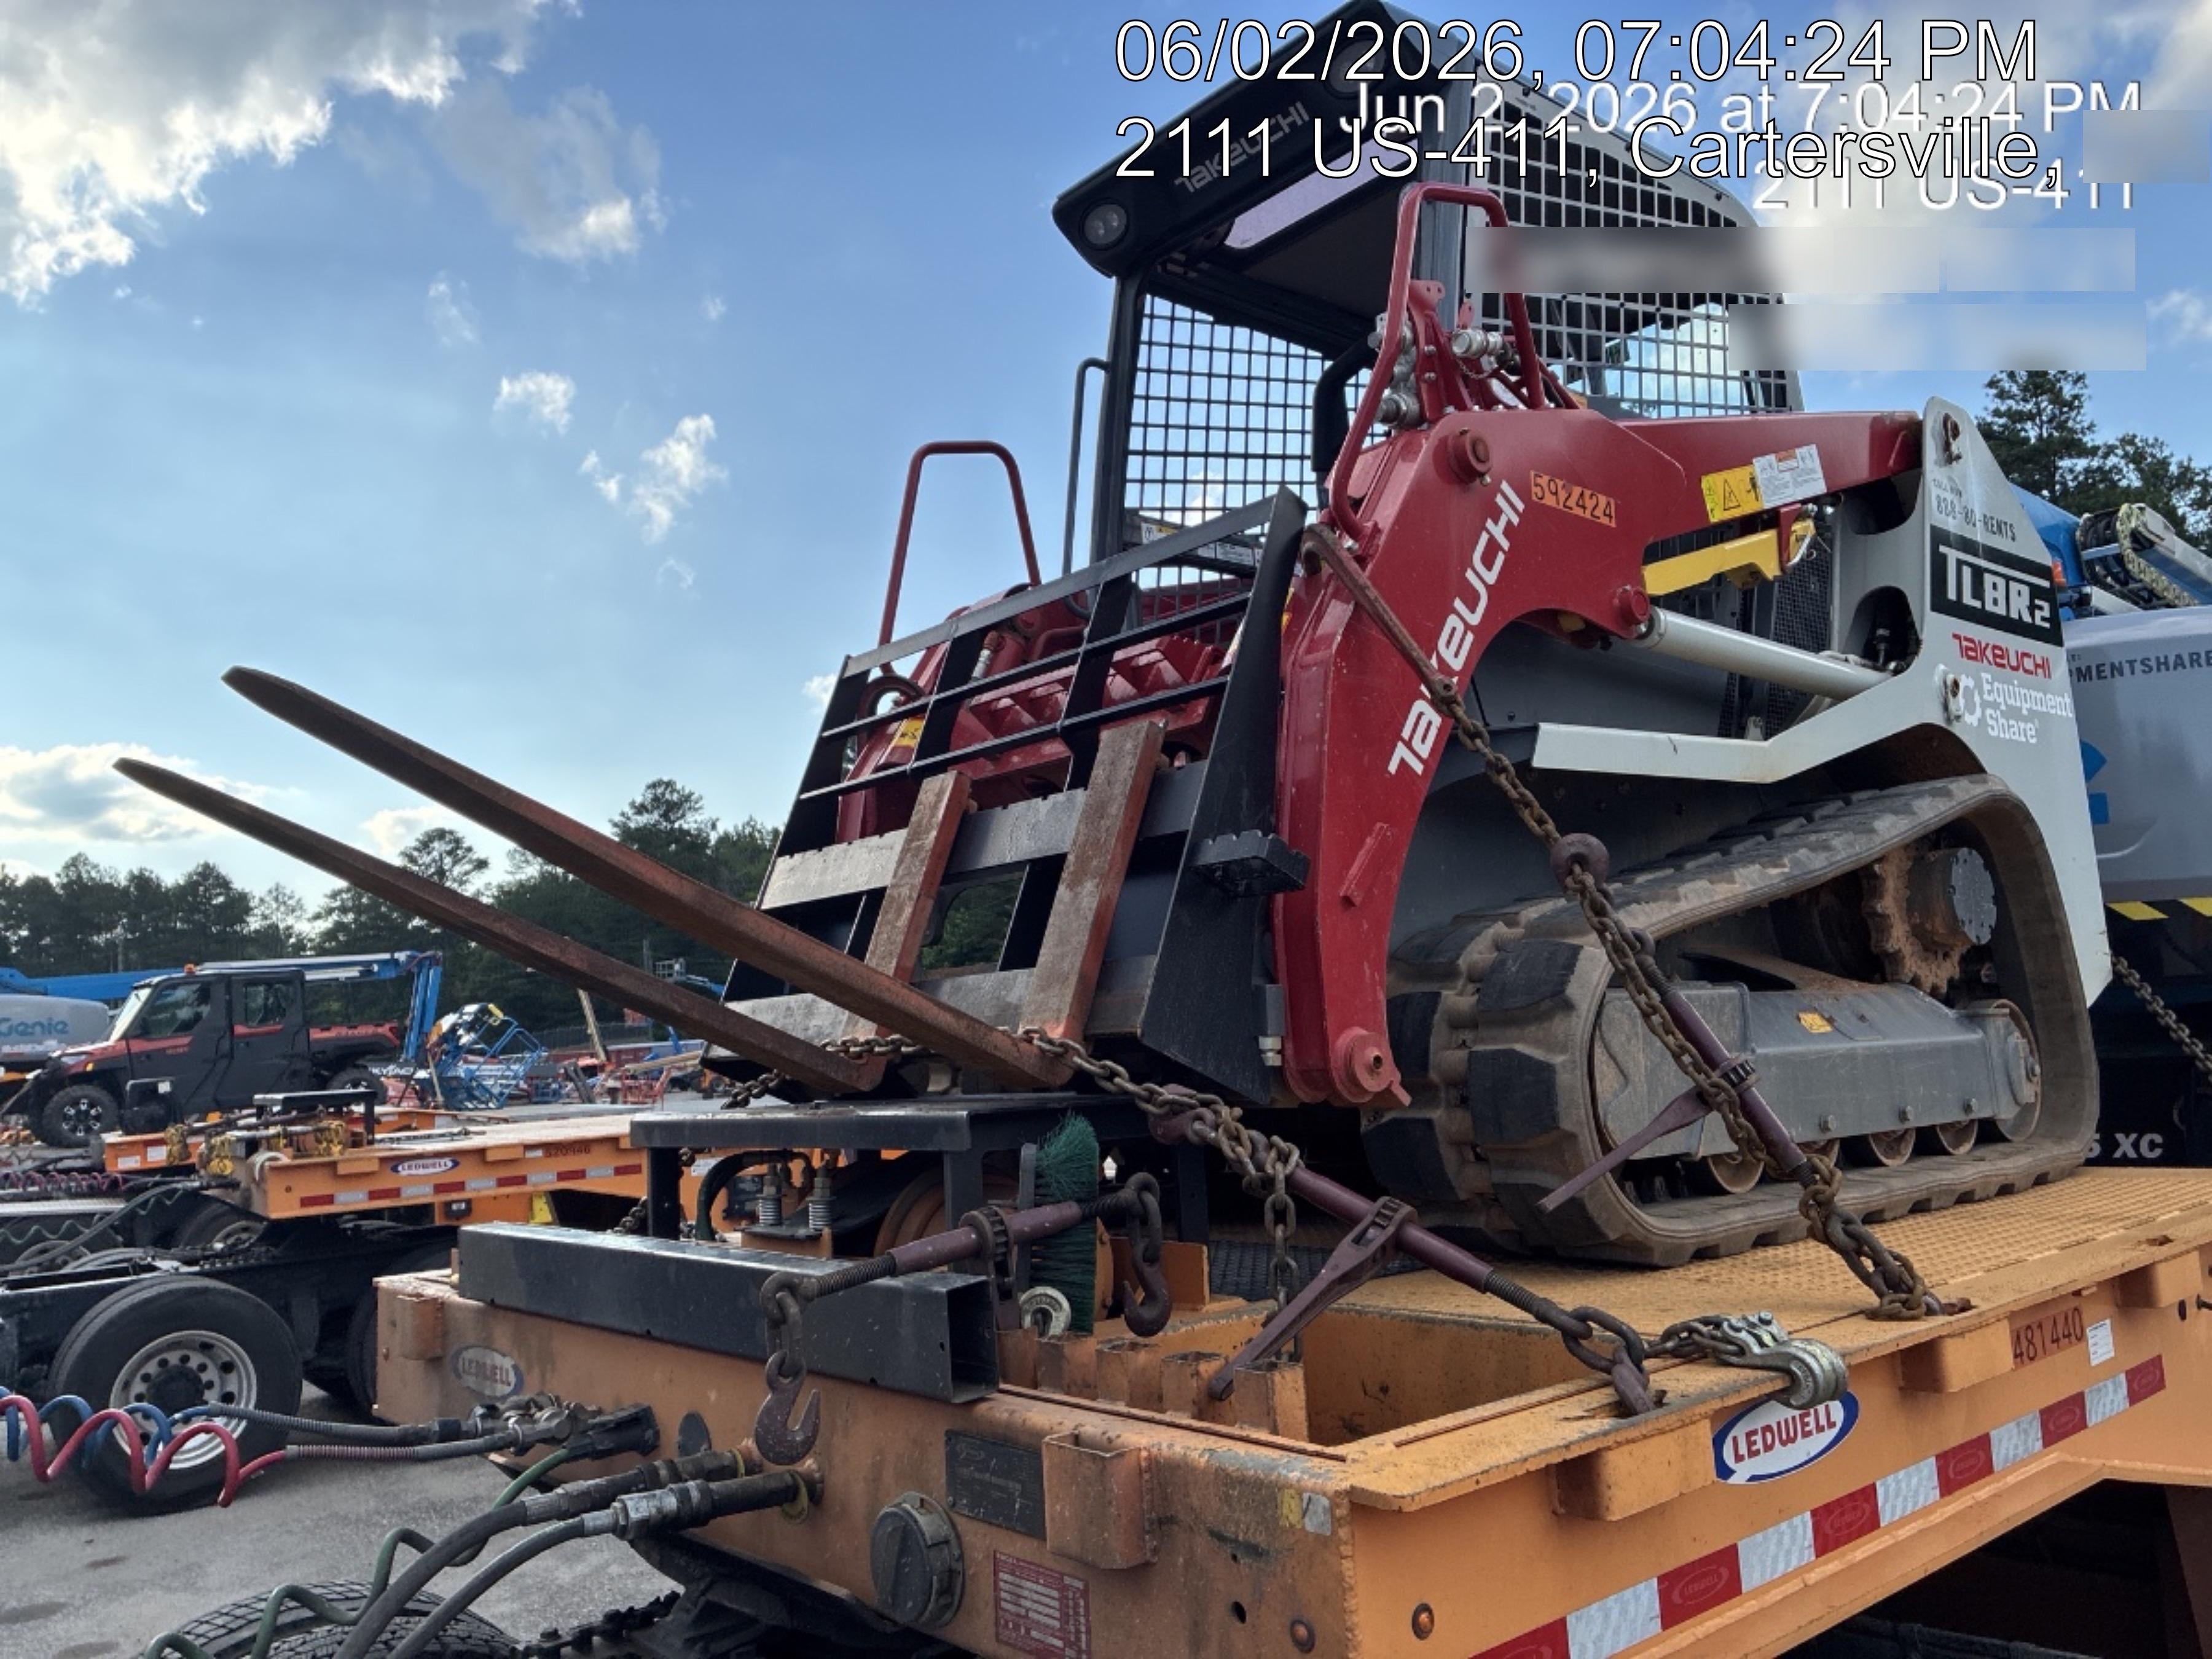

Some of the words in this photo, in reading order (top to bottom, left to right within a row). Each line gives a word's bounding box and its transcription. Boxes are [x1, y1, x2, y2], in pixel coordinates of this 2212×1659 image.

[1533, 473, 1614, 524] 592424
[1387, 479, 1525, 775] TAEUCHI
[1951, 632, 2052, 680] TAKEUCHI
[1980, 672, 2074, 718] Equipment
[1985, 707, 2038, 744] Share
[2112, 1133, 2164, 1159] XC
[2013, 1306, 2085, 1365] 481440
[461, 1355, 512, 1387] LEDWELL
[1731, 1403, 1838, 1465] LEDWELL
